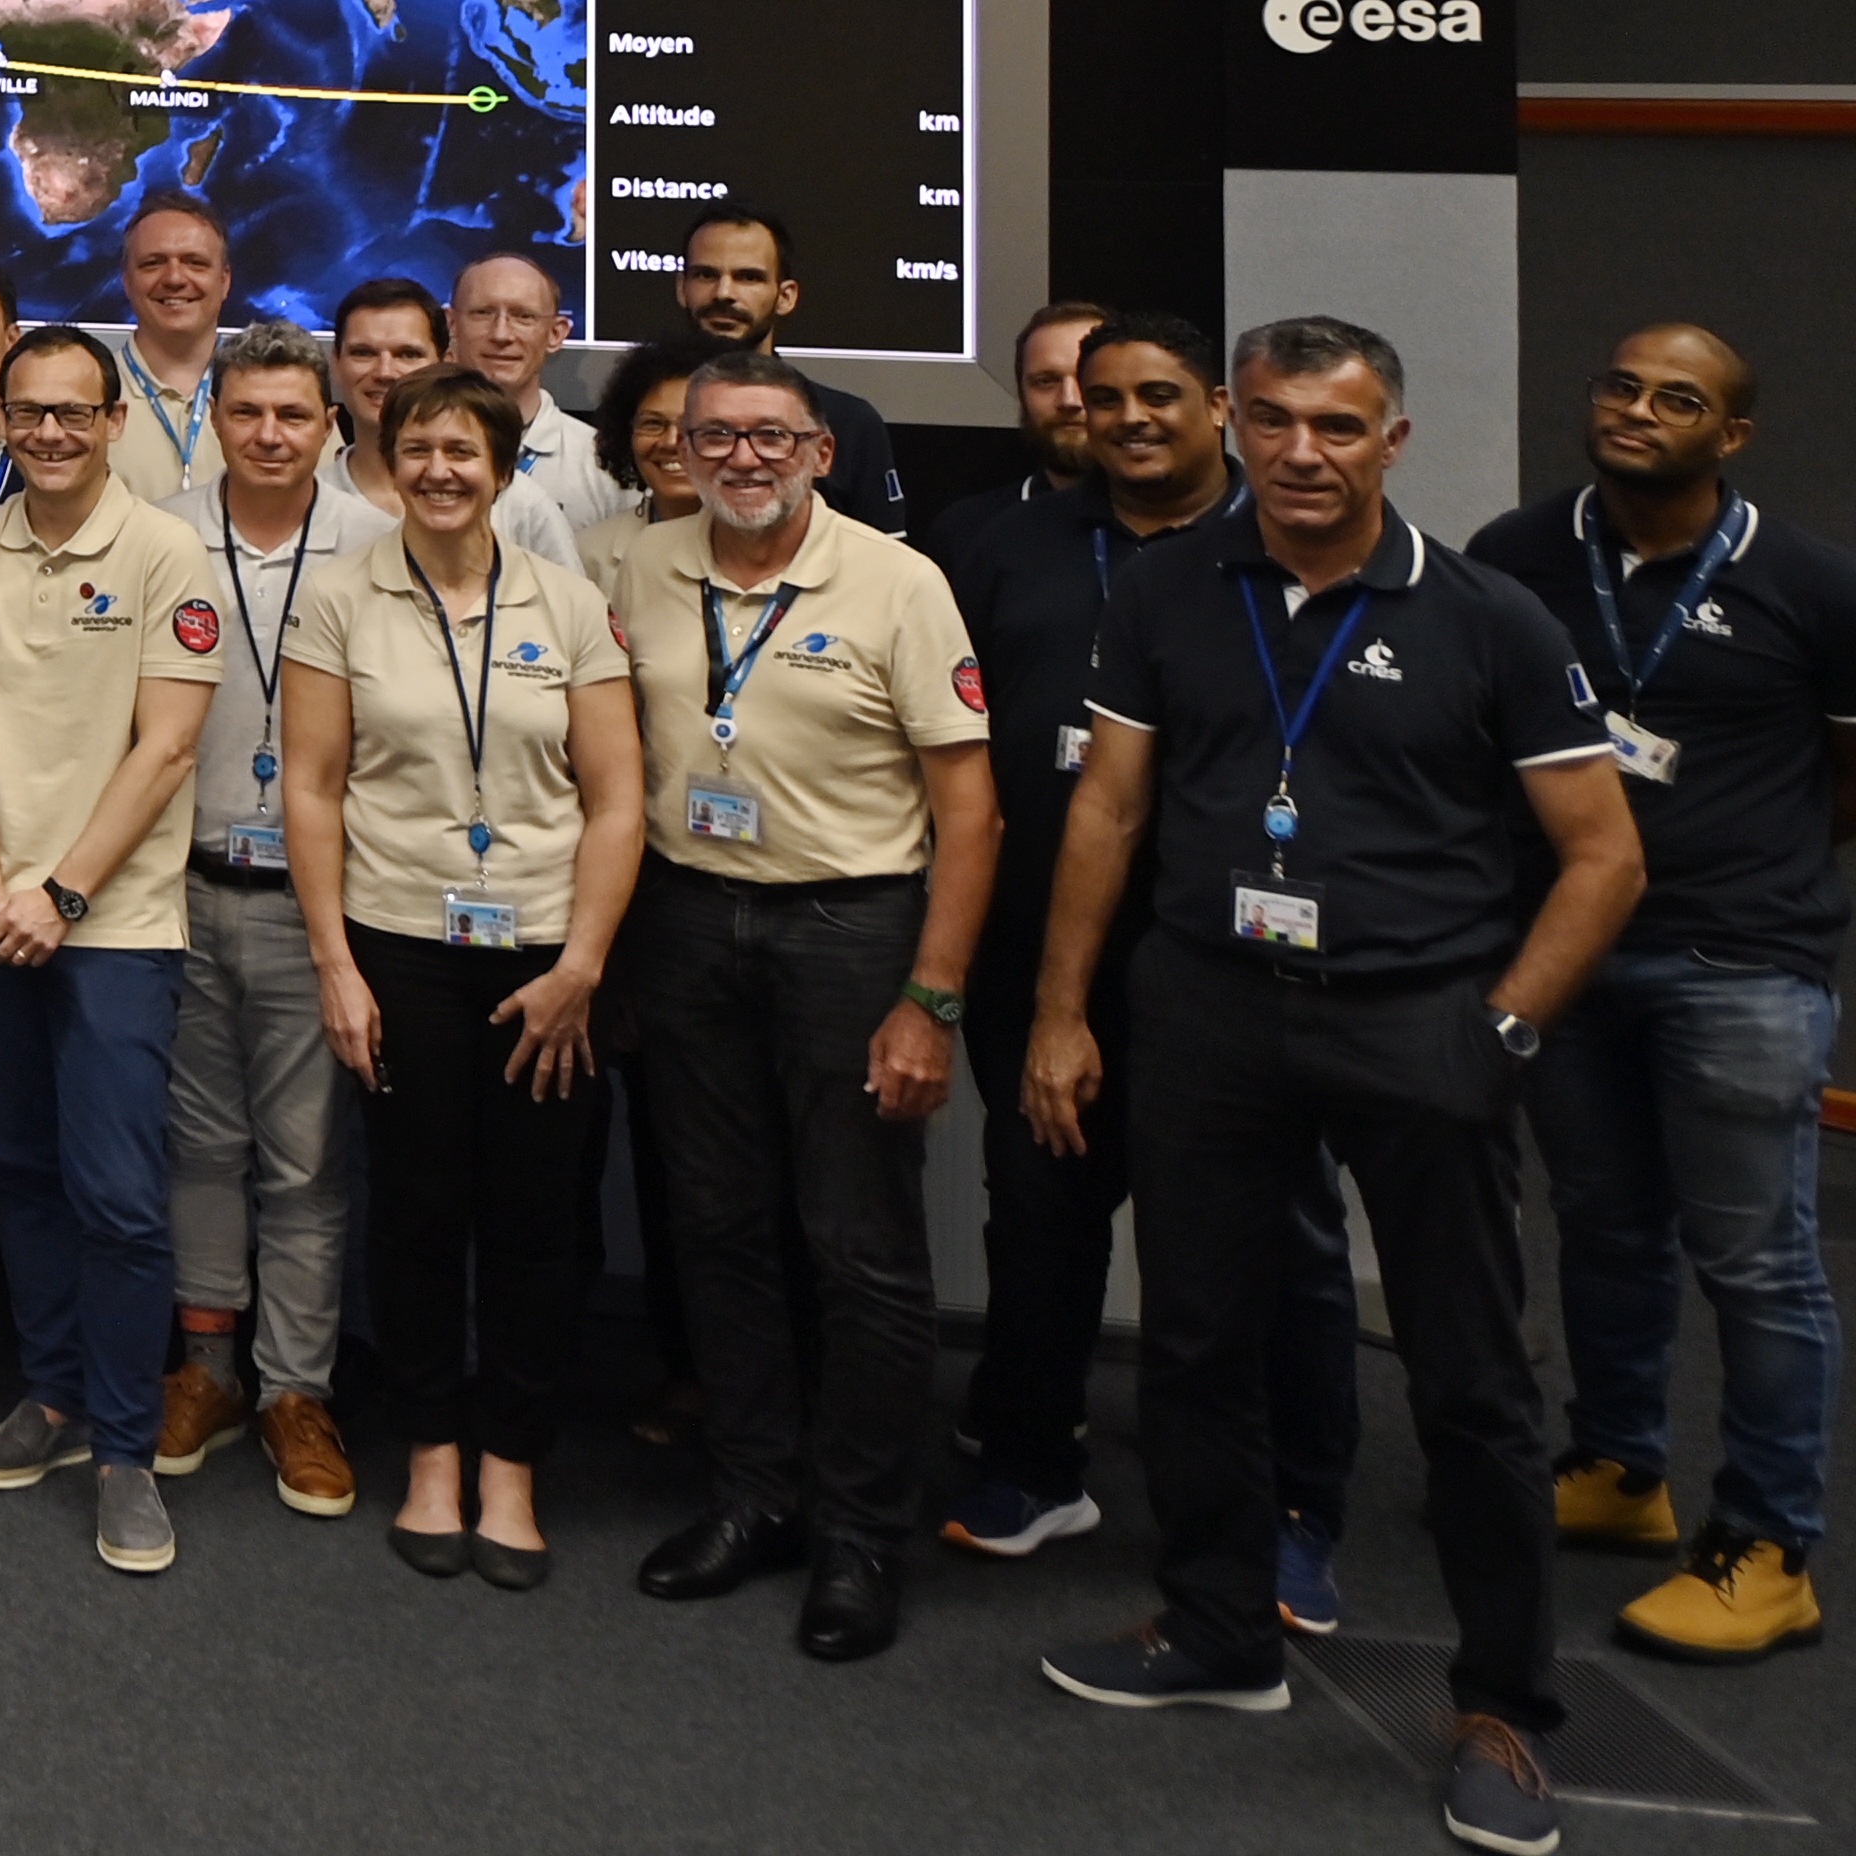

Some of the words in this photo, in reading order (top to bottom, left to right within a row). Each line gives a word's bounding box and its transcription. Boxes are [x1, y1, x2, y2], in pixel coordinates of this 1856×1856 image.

[609, 33, 693, 57] Moyen
[130, 91, 208, 108] MALINDI
[610, 105, 715, 126] Altitude
[919, 111, 959, 131] km
[612, 178, 728, 199] Distance
[919, 186, 959, 206] km
[897, 259, 958, 280] km/s
